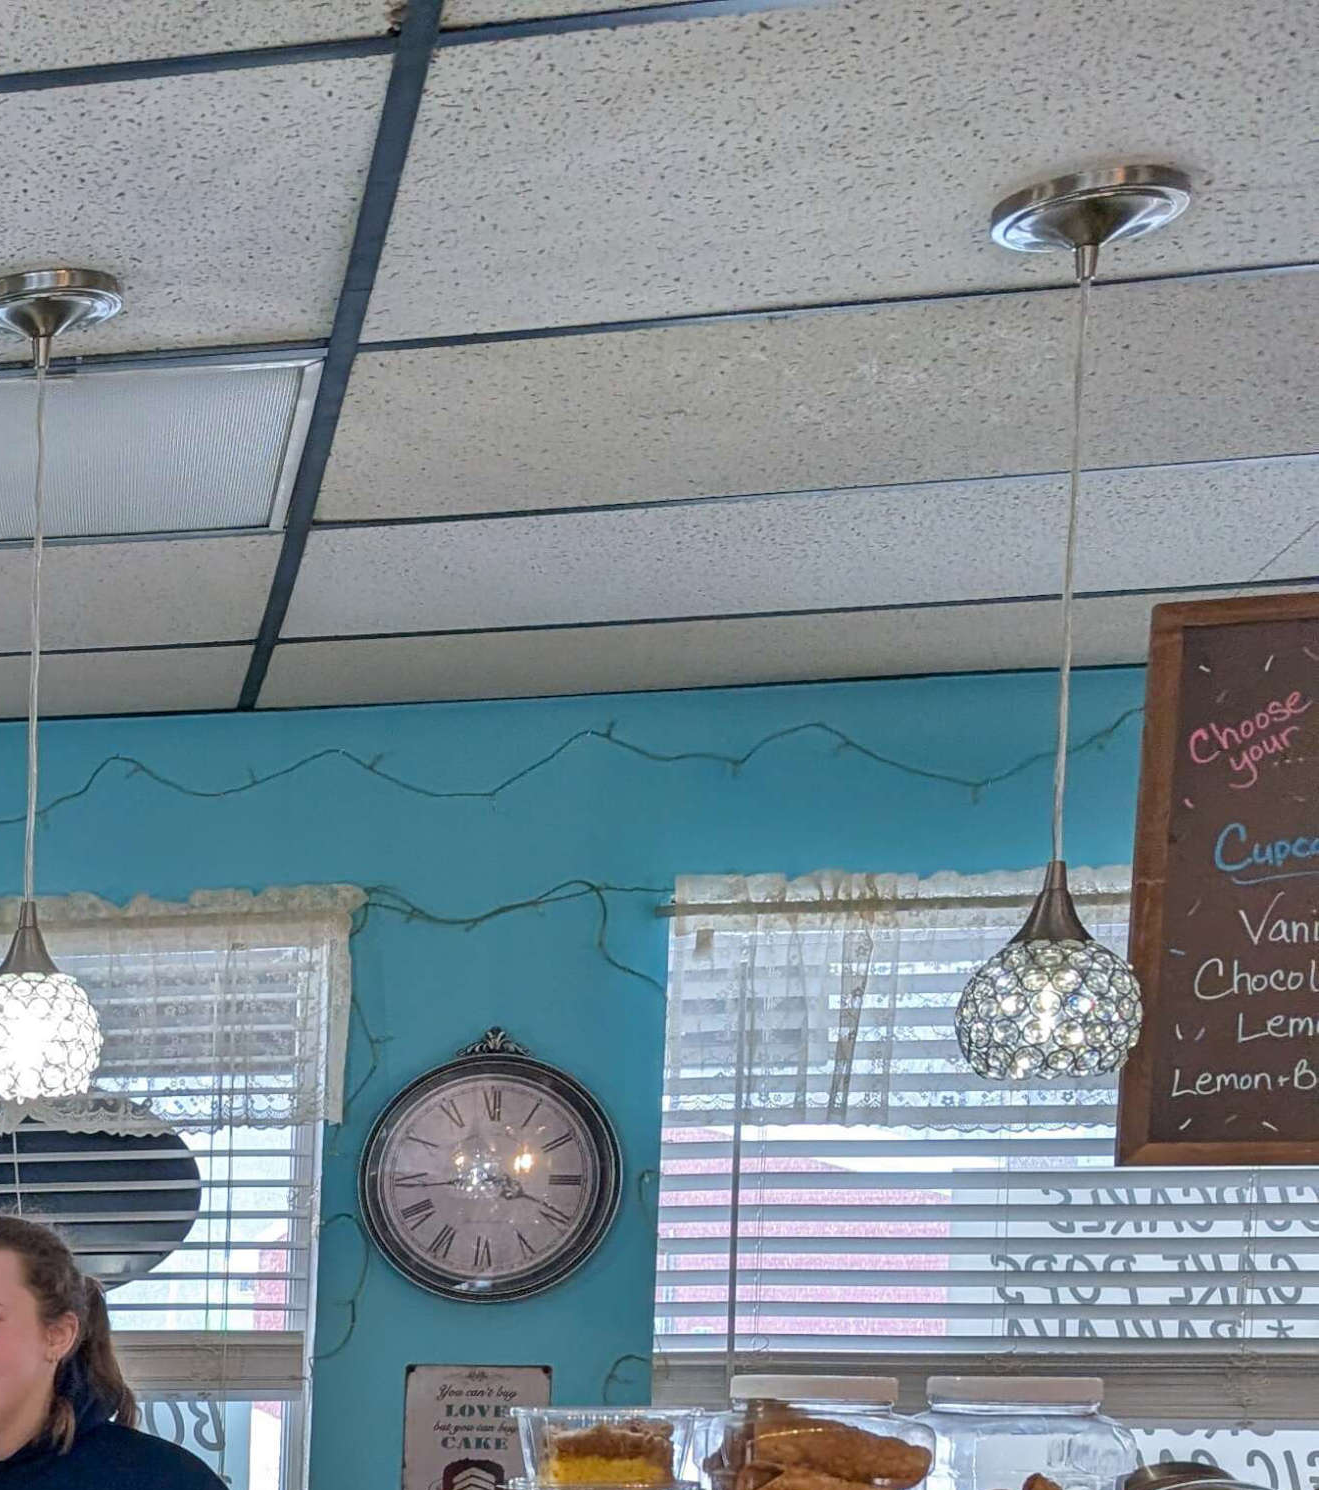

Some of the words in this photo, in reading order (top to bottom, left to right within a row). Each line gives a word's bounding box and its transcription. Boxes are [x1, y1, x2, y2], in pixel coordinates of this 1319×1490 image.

[1189, 691, 1313, 764] Choose
[1229, 726, 1301, 789] your
[436, 1384, 462, 1401] You
[465, 1387, 493, 1398] can't
[497, 1386, 517, 1399] buy
[445, 1404, 509, 1418] LOVE
[433, 1420, 451, 1431] but
[449, 1424, 473, 1435] you
[476, 1424, 494, 1432] can
[441, 1436, 508, 1450] CAKE
